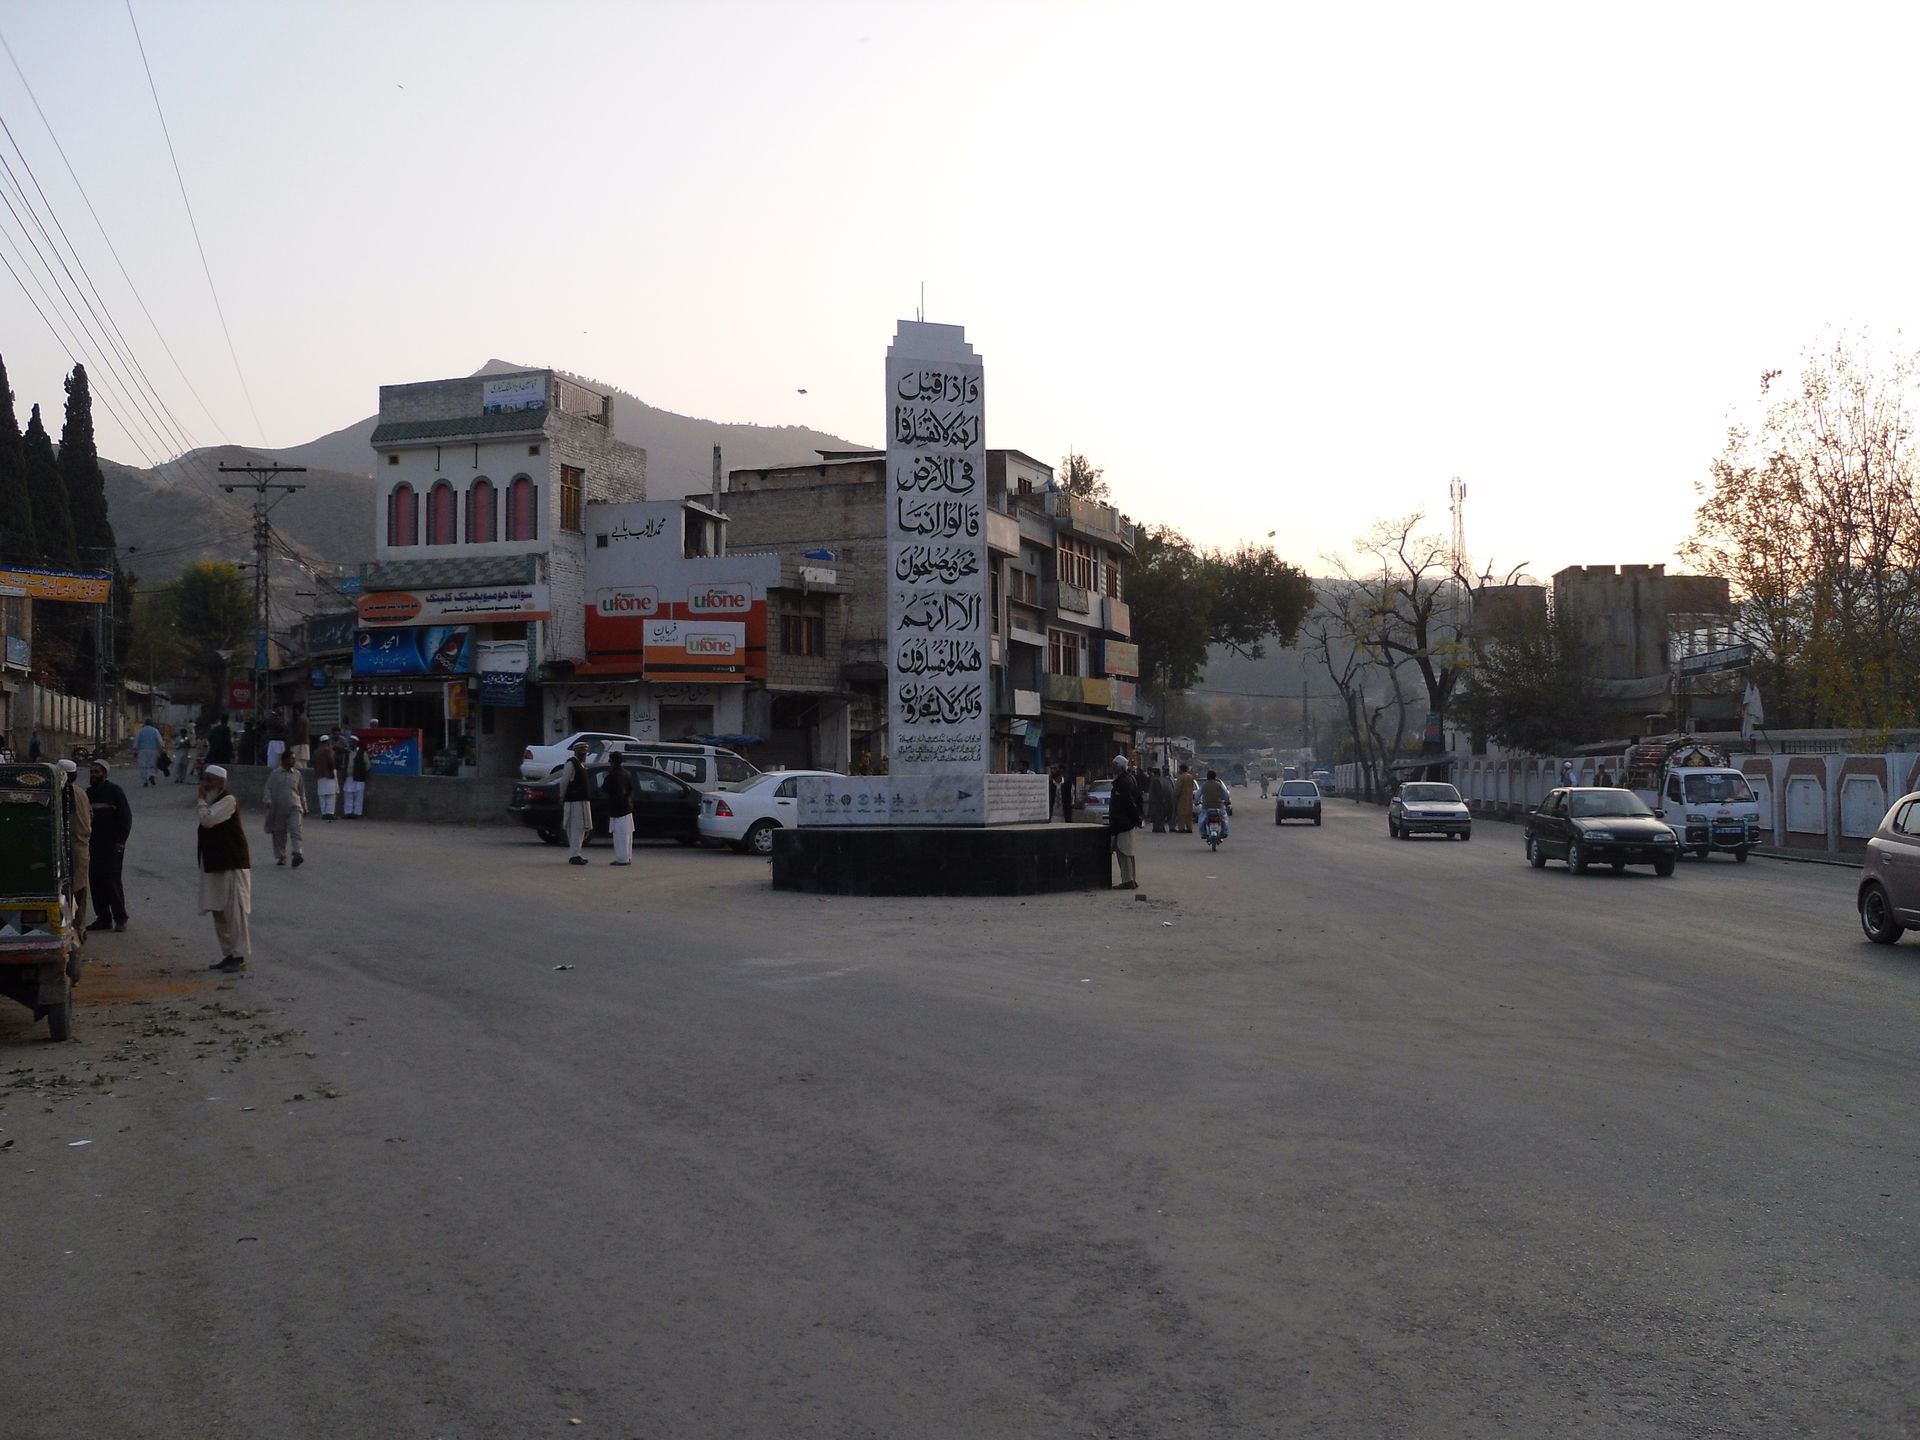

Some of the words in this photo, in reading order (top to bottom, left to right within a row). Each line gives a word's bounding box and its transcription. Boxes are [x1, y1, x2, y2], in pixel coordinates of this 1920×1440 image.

[602, 592, 652, 611] ufone
[694, 589, 745, 608] ufone
[654, 622, 678, 636] فرمان
[378, 634, 400, 653] امجد
[688, 638, 732, 652] ufone
